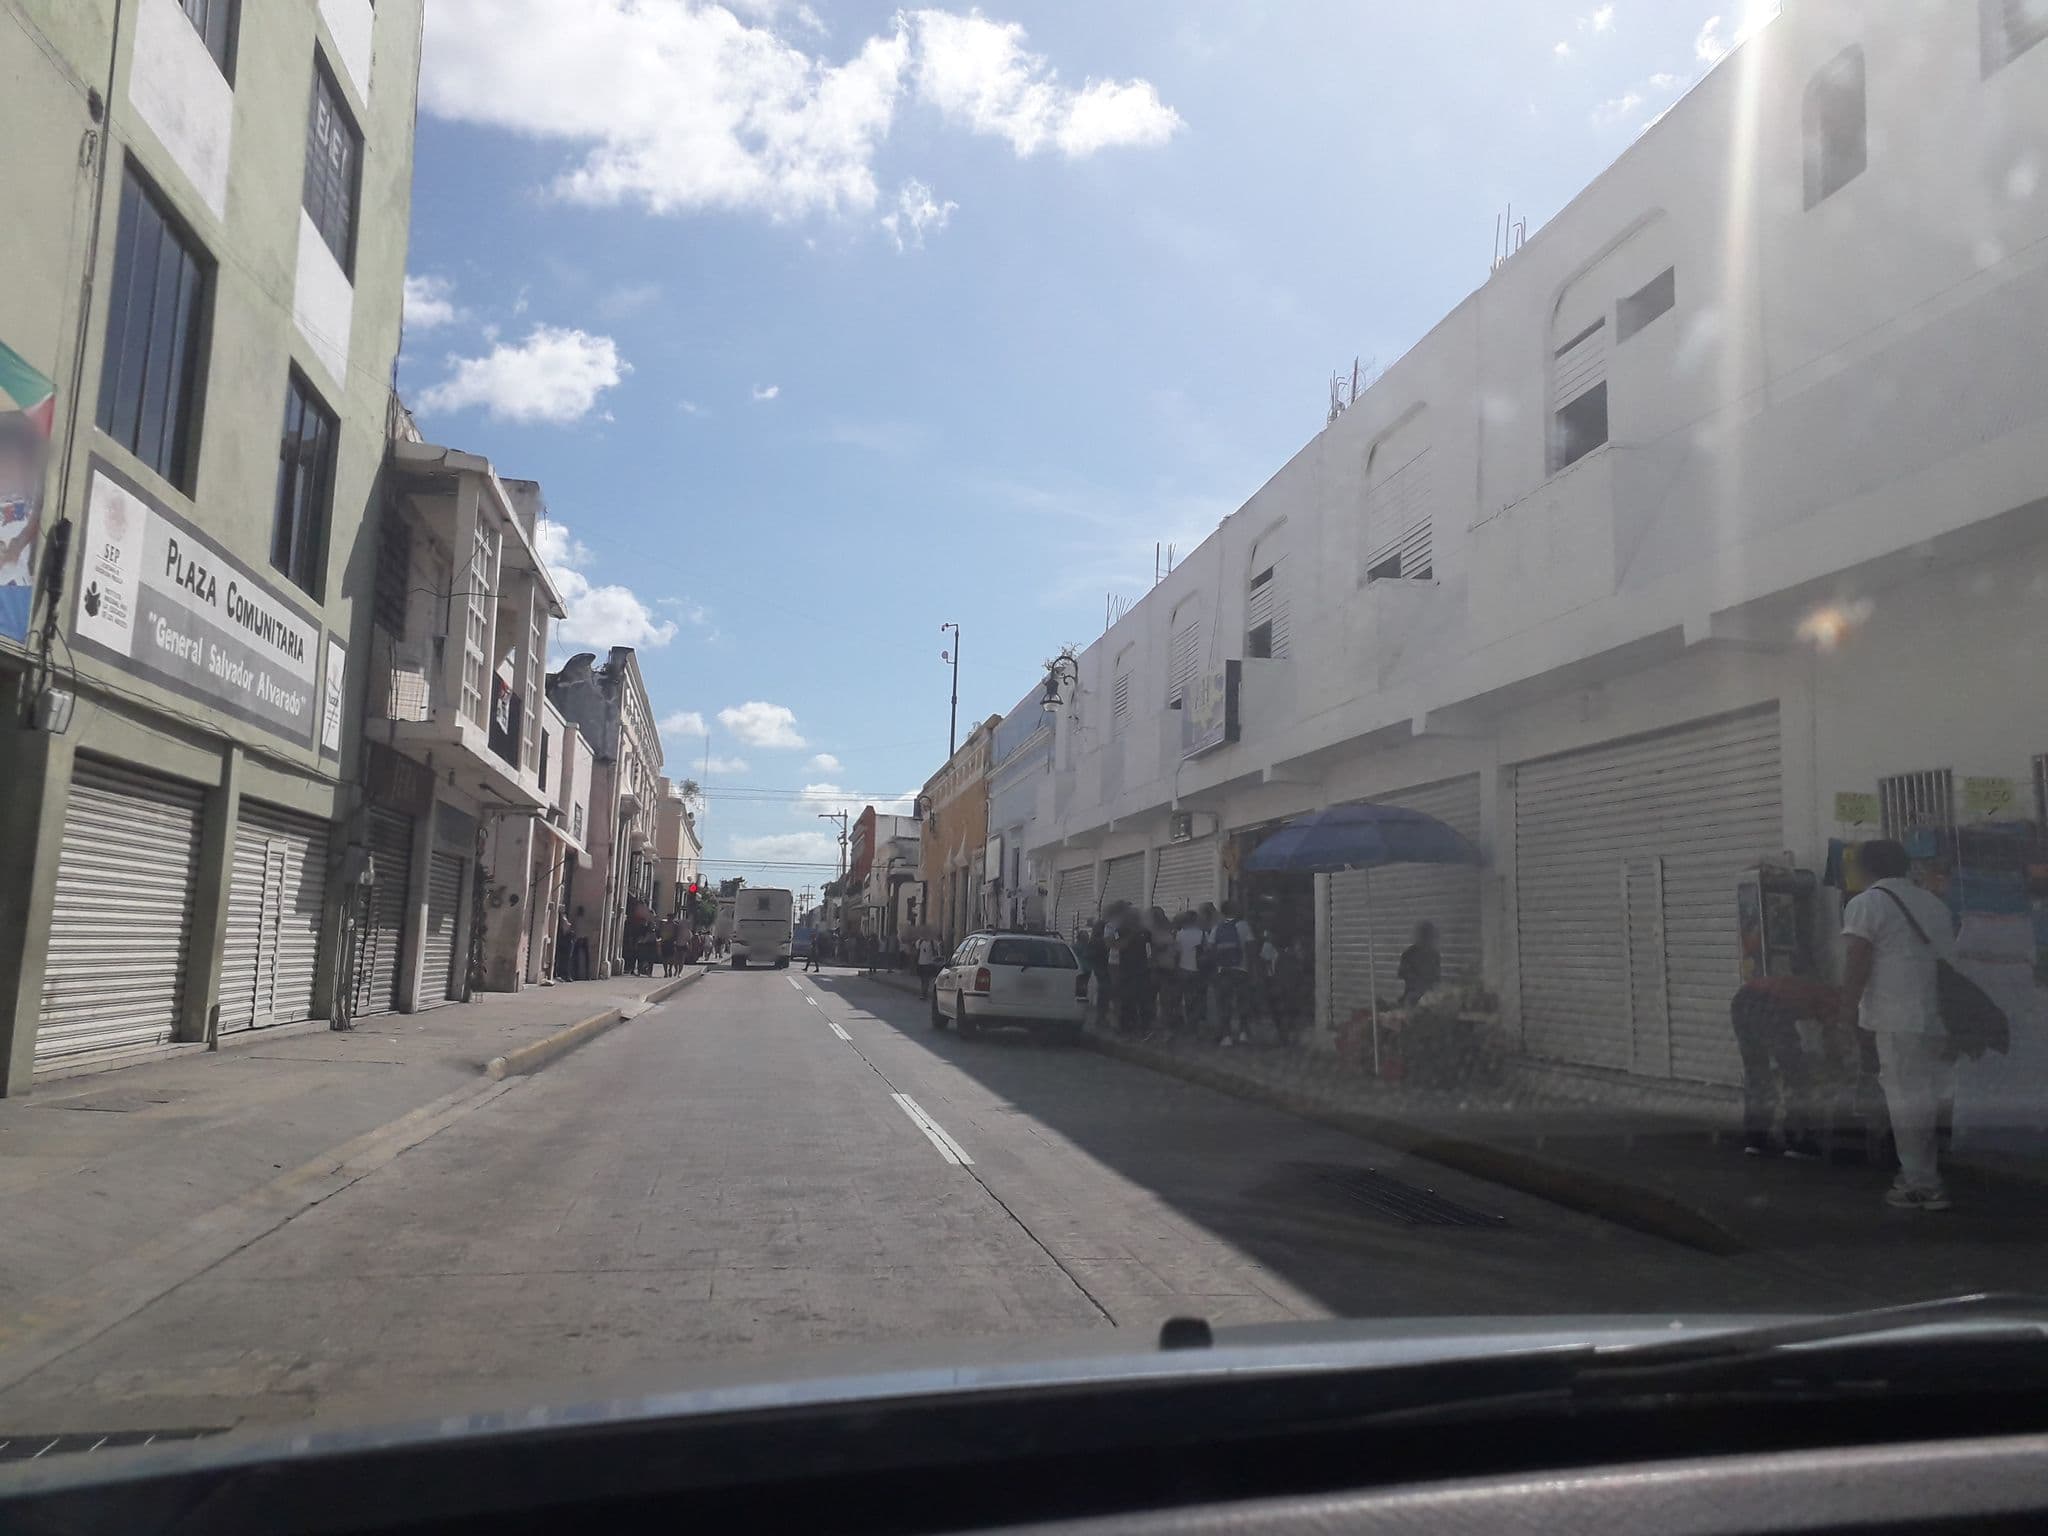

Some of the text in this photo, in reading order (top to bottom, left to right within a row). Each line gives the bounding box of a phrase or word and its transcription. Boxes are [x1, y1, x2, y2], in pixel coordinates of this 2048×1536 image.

[104, 543, 121, 564] SEP
[166, 537, 217, 608] PLAZA
[226, 580, 305, 664] COMUNITARIA
[208, 643, 255, 692] Salvador
